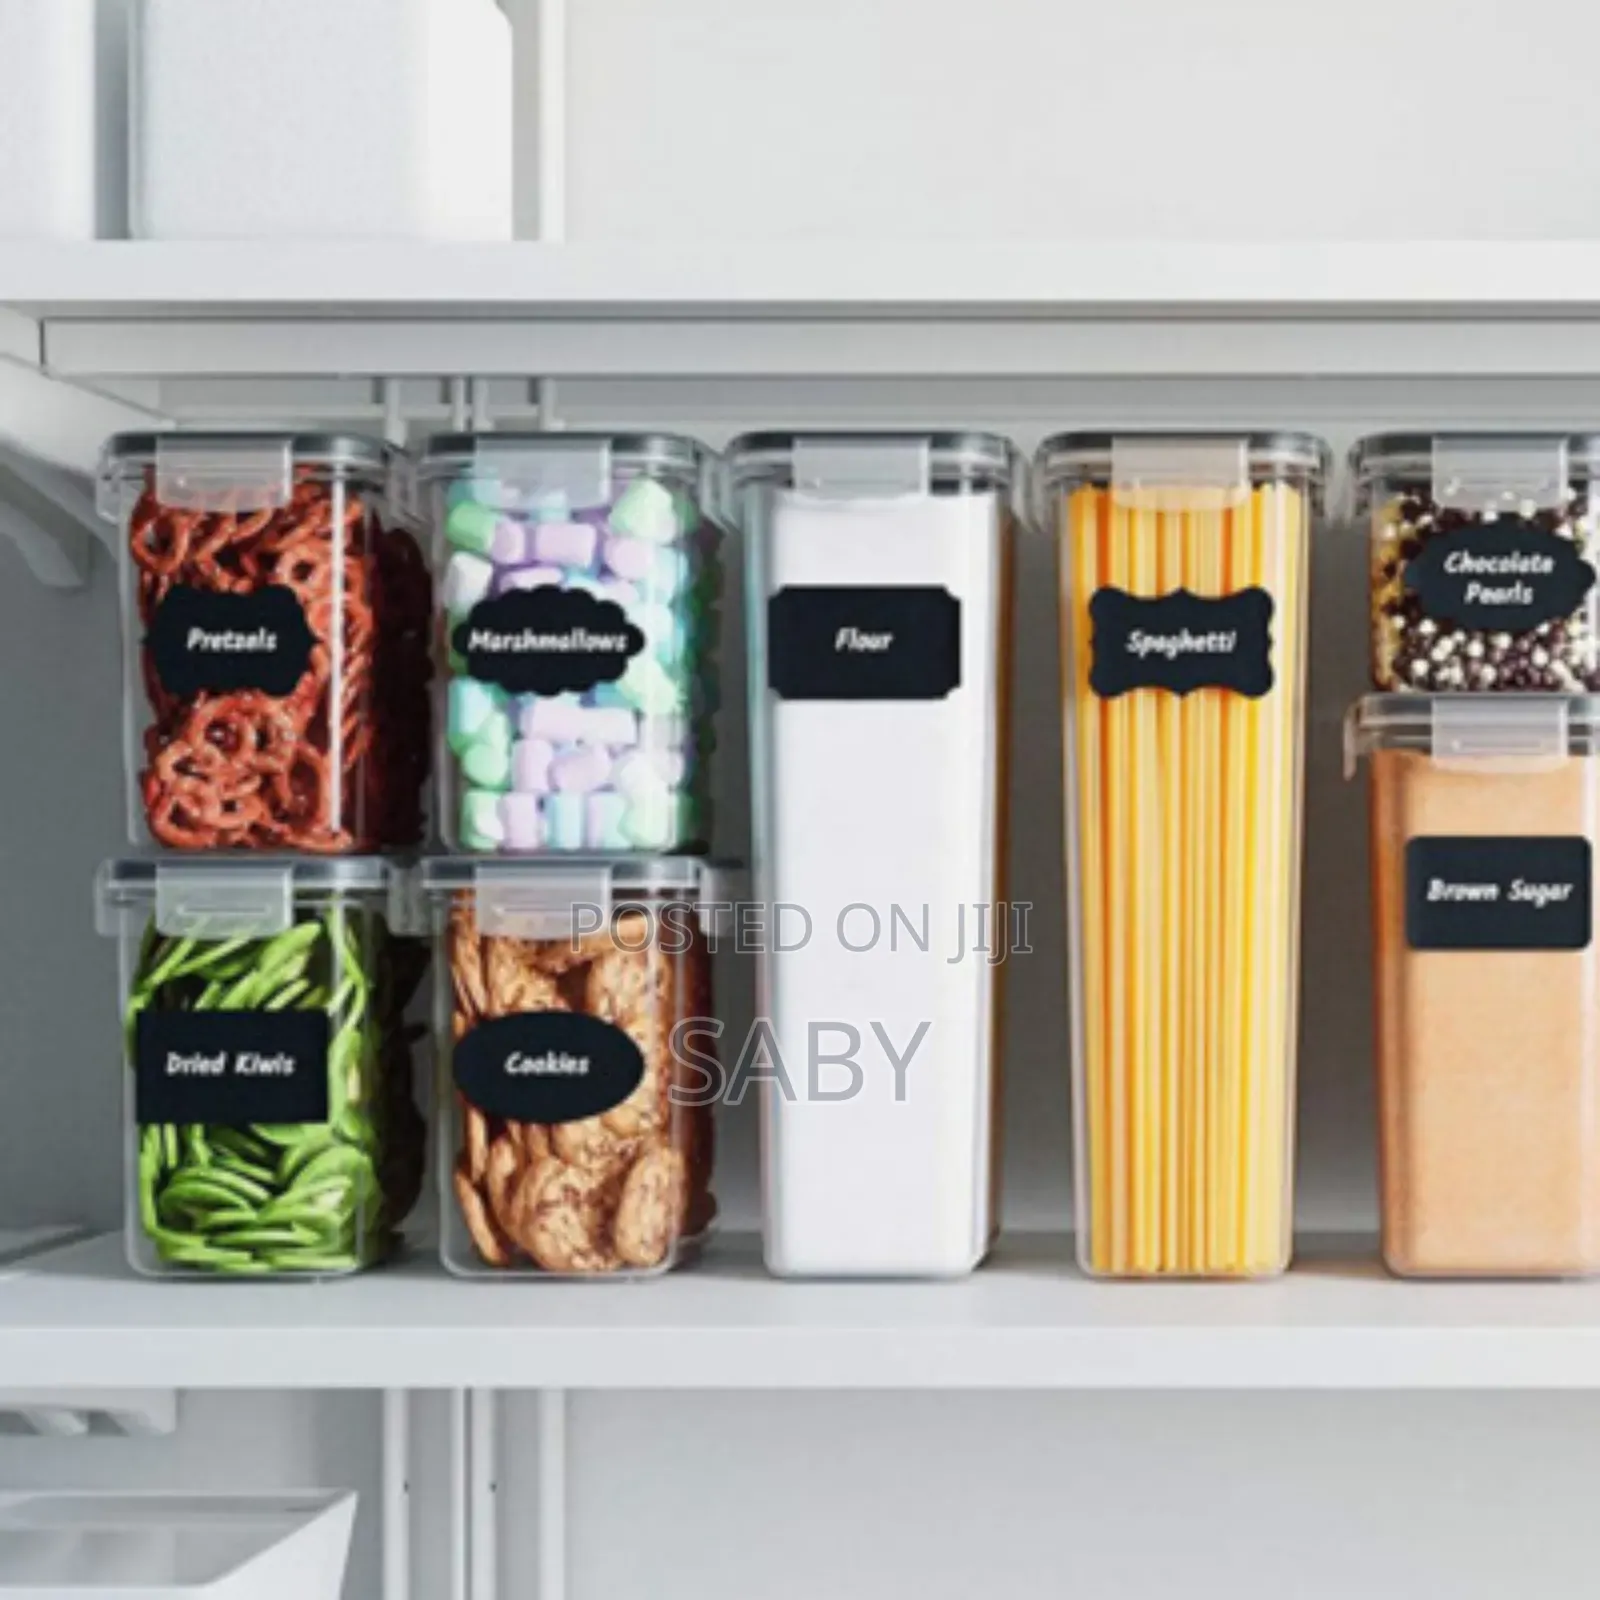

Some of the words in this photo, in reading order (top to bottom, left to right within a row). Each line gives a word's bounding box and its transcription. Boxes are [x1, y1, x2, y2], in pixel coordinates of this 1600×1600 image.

[1443, 549, 1555, 575] Chocolate
[1464, 580, 1534, 606] Pearls
[186, 627, 278, 652] Pretzels
[467, 627, 629, 653] Marshmallows
[834, 627, 894, 653] Flour
[1126, 627, 1238, 660] Spaghetti
[1426, 877, 1500, 903] Brown
[1507, 877, 1574, 908] Sugar
[165, 1051, 227, 1076] Dried
[234, 1051, 295, 1076] Kiwis
[504, 1051, 590, 1076] Cookies
